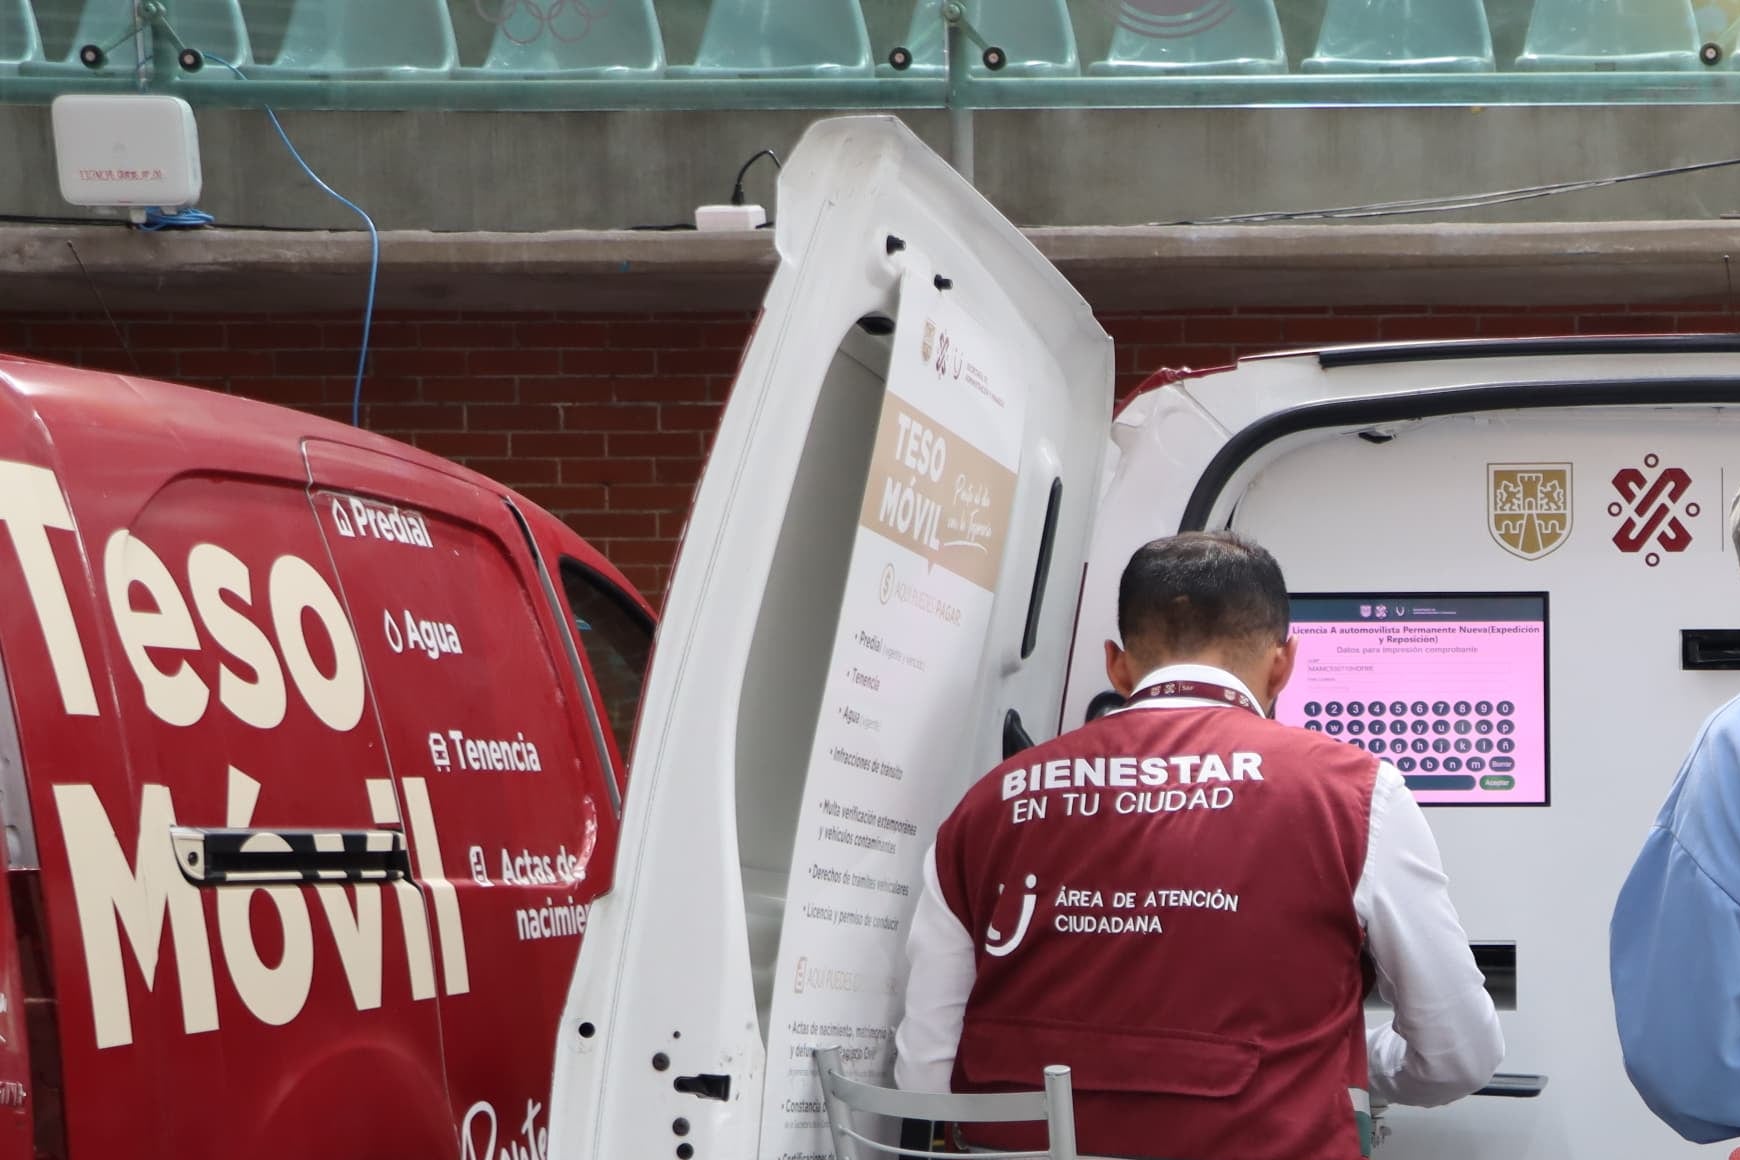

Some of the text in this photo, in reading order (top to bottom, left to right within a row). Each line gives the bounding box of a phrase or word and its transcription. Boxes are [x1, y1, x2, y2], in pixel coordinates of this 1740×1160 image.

[895, 411, 947, 483] TESO
[350, 497, 434, 548] Predial
[879, 476, 943, 550] MÓVIL
[0, 459, 366, 732] Teso
[403, 609, 463, 660] Agua
[1292, 625, 1328, 635] Licencia
[1331, 626, 1337, 634] A
[1340, 625, 1400, 635] automovilista
[1403, 626, 1457, 634] Permanente
[852, 667, 881, 692] Tenencia
[449, 729, 542, 772] Tenencia
[1002, 752, 1264, 801] BIENESTAR
[1013, 786, 1234, 824] EN TU CIUDAD
[502, 847, 557, 886] Actas
[53, 765, 470, 1050] Móvil
[1055, 885, 1239, 912] ÁREA DE ATENCIÓN
[1055, 914, 1163, 934] CIUDADANA
